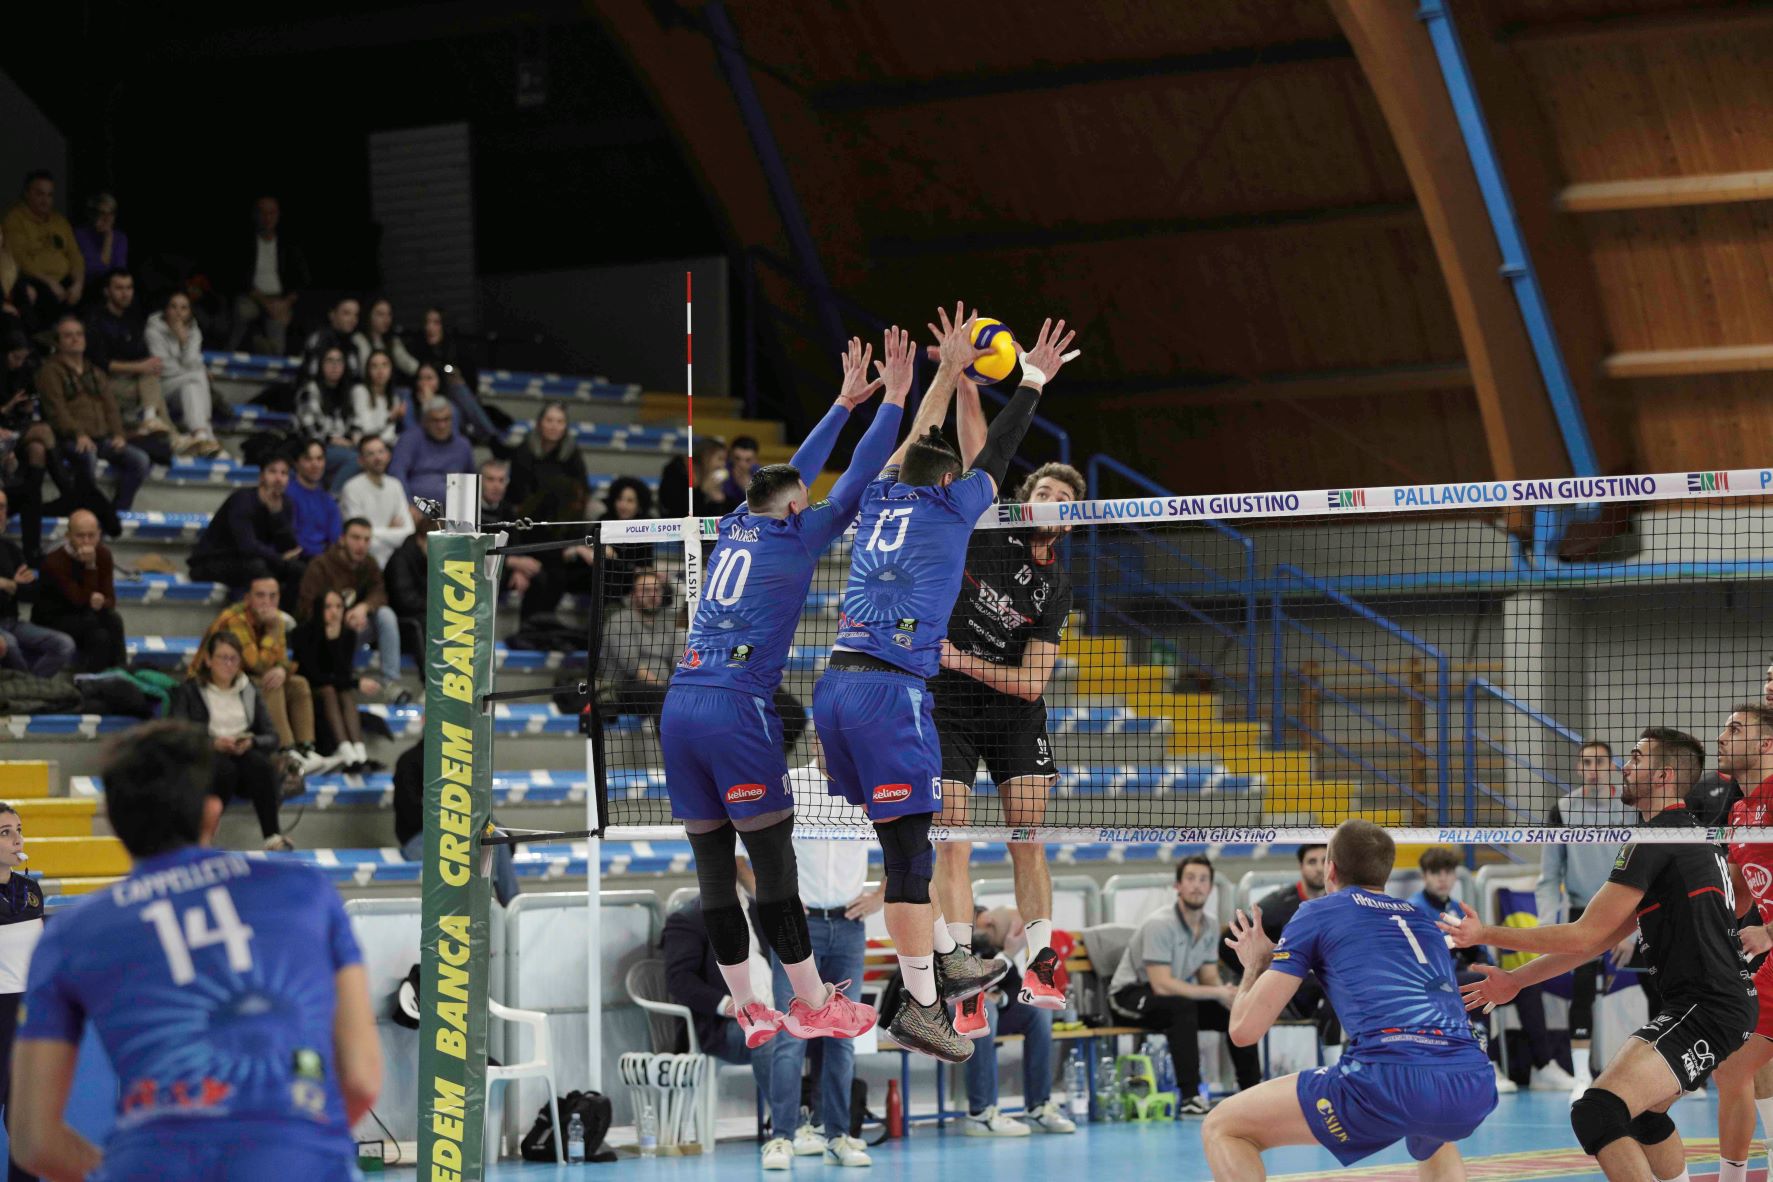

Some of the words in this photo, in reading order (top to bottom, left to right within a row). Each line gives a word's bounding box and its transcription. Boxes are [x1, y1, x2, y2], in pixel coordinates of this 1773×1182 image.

[1059, 500, 1164, 521] PALLAVOLO
[1168, 498, 1206, 516] SAN
[1209, 494, 1300, 514] GIUSTINO
[1393, 484, 1508, 506] PALLAVOLO
[1512, 480, 1553, 501] SAN
[1558, 476, 1656, 500] GIUSTINO
[865, 507, 914, 552] 15
[688, 553, 697, 599] ALLSIX
[705, 547, 752, 606] 10
[442, 560, 476, 704] BANCA
[439, 720, 473, 887] CREDEM
[727, 788, 764, 801] kelinea
[873, 788, 910, 801] kelinea
[932, 776, 942, 800] 15
[793, 829, 855, 840] ALLAVOLO
[1099, 830, 1176, 842] PALLAVOLO
[1179, 830, 1208, 842] SAN
[1210, 830, 1276, 842] GIUSTINO
[1438, 829, 1523, 843] PALLAVOLO
[1526, 829, 1556, 843] SAN
[1559, 829, 1632, 843] GIUSTINO
[139, 885, 255, 986] 14
[1389, 914, 1429, 964] 1
[435, 915, 471, 1060] BANCA
